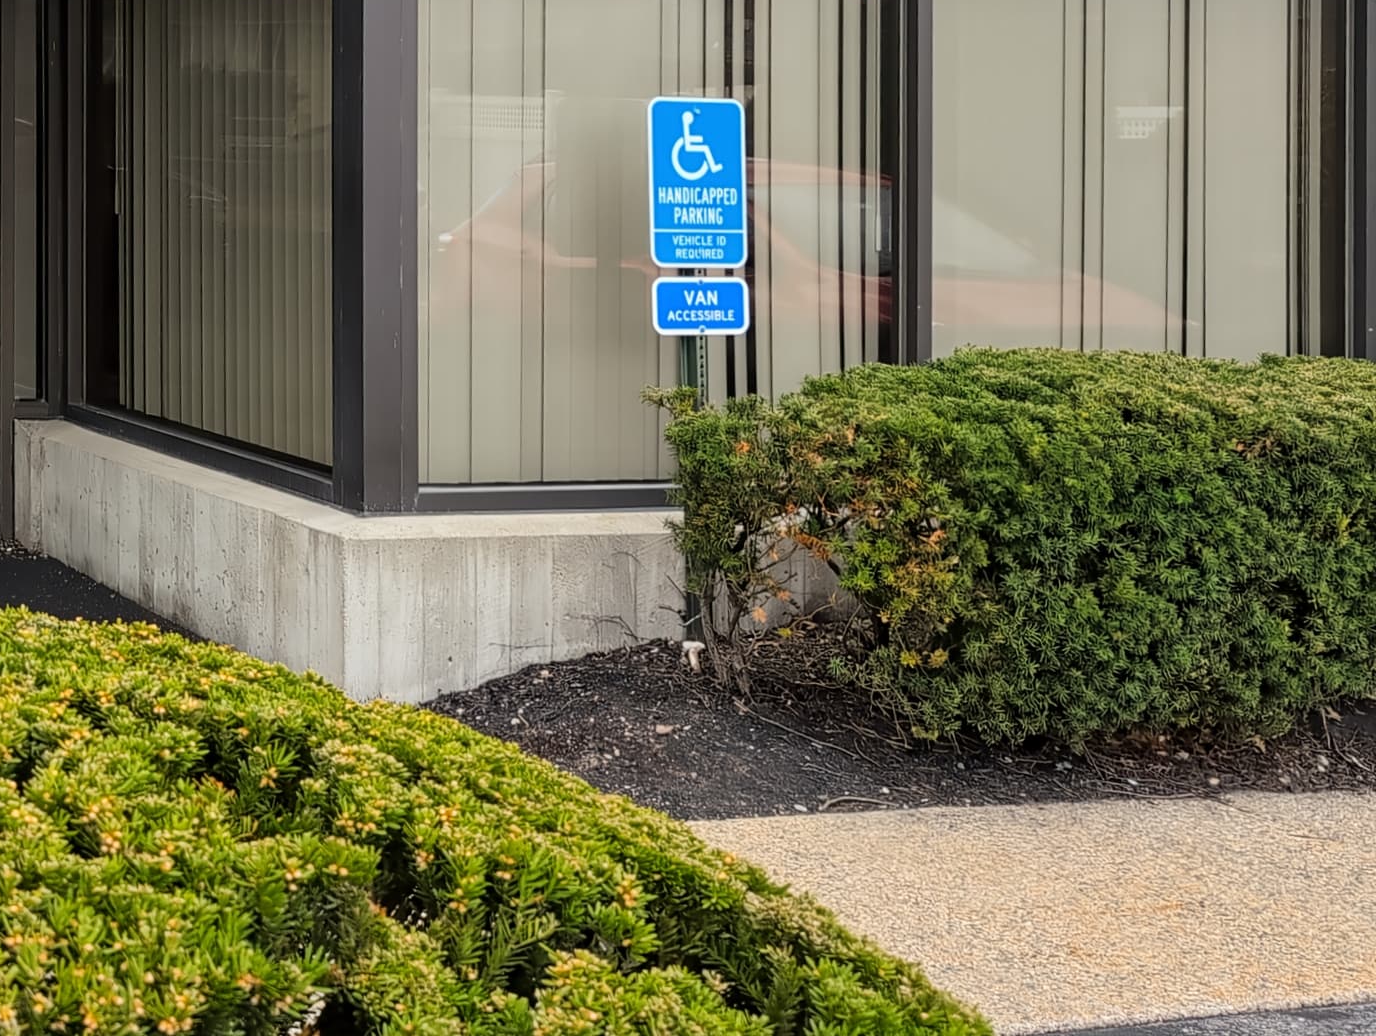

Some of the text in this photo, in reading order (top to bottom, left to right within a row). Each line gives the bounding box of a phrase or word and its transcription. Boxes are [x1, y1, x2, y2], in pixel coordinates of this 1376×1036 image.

[658, 187, 737, 206] HANDICAPPED
[673, 207, 723, 225] PARKING
[672, 235, 727, 247] VEHICLE ID
[675, 248, 724, 260] REQUIRED
[684, 290, 718, 306] VAN
[667, 310, 735, 323] ACCESSIBLE
